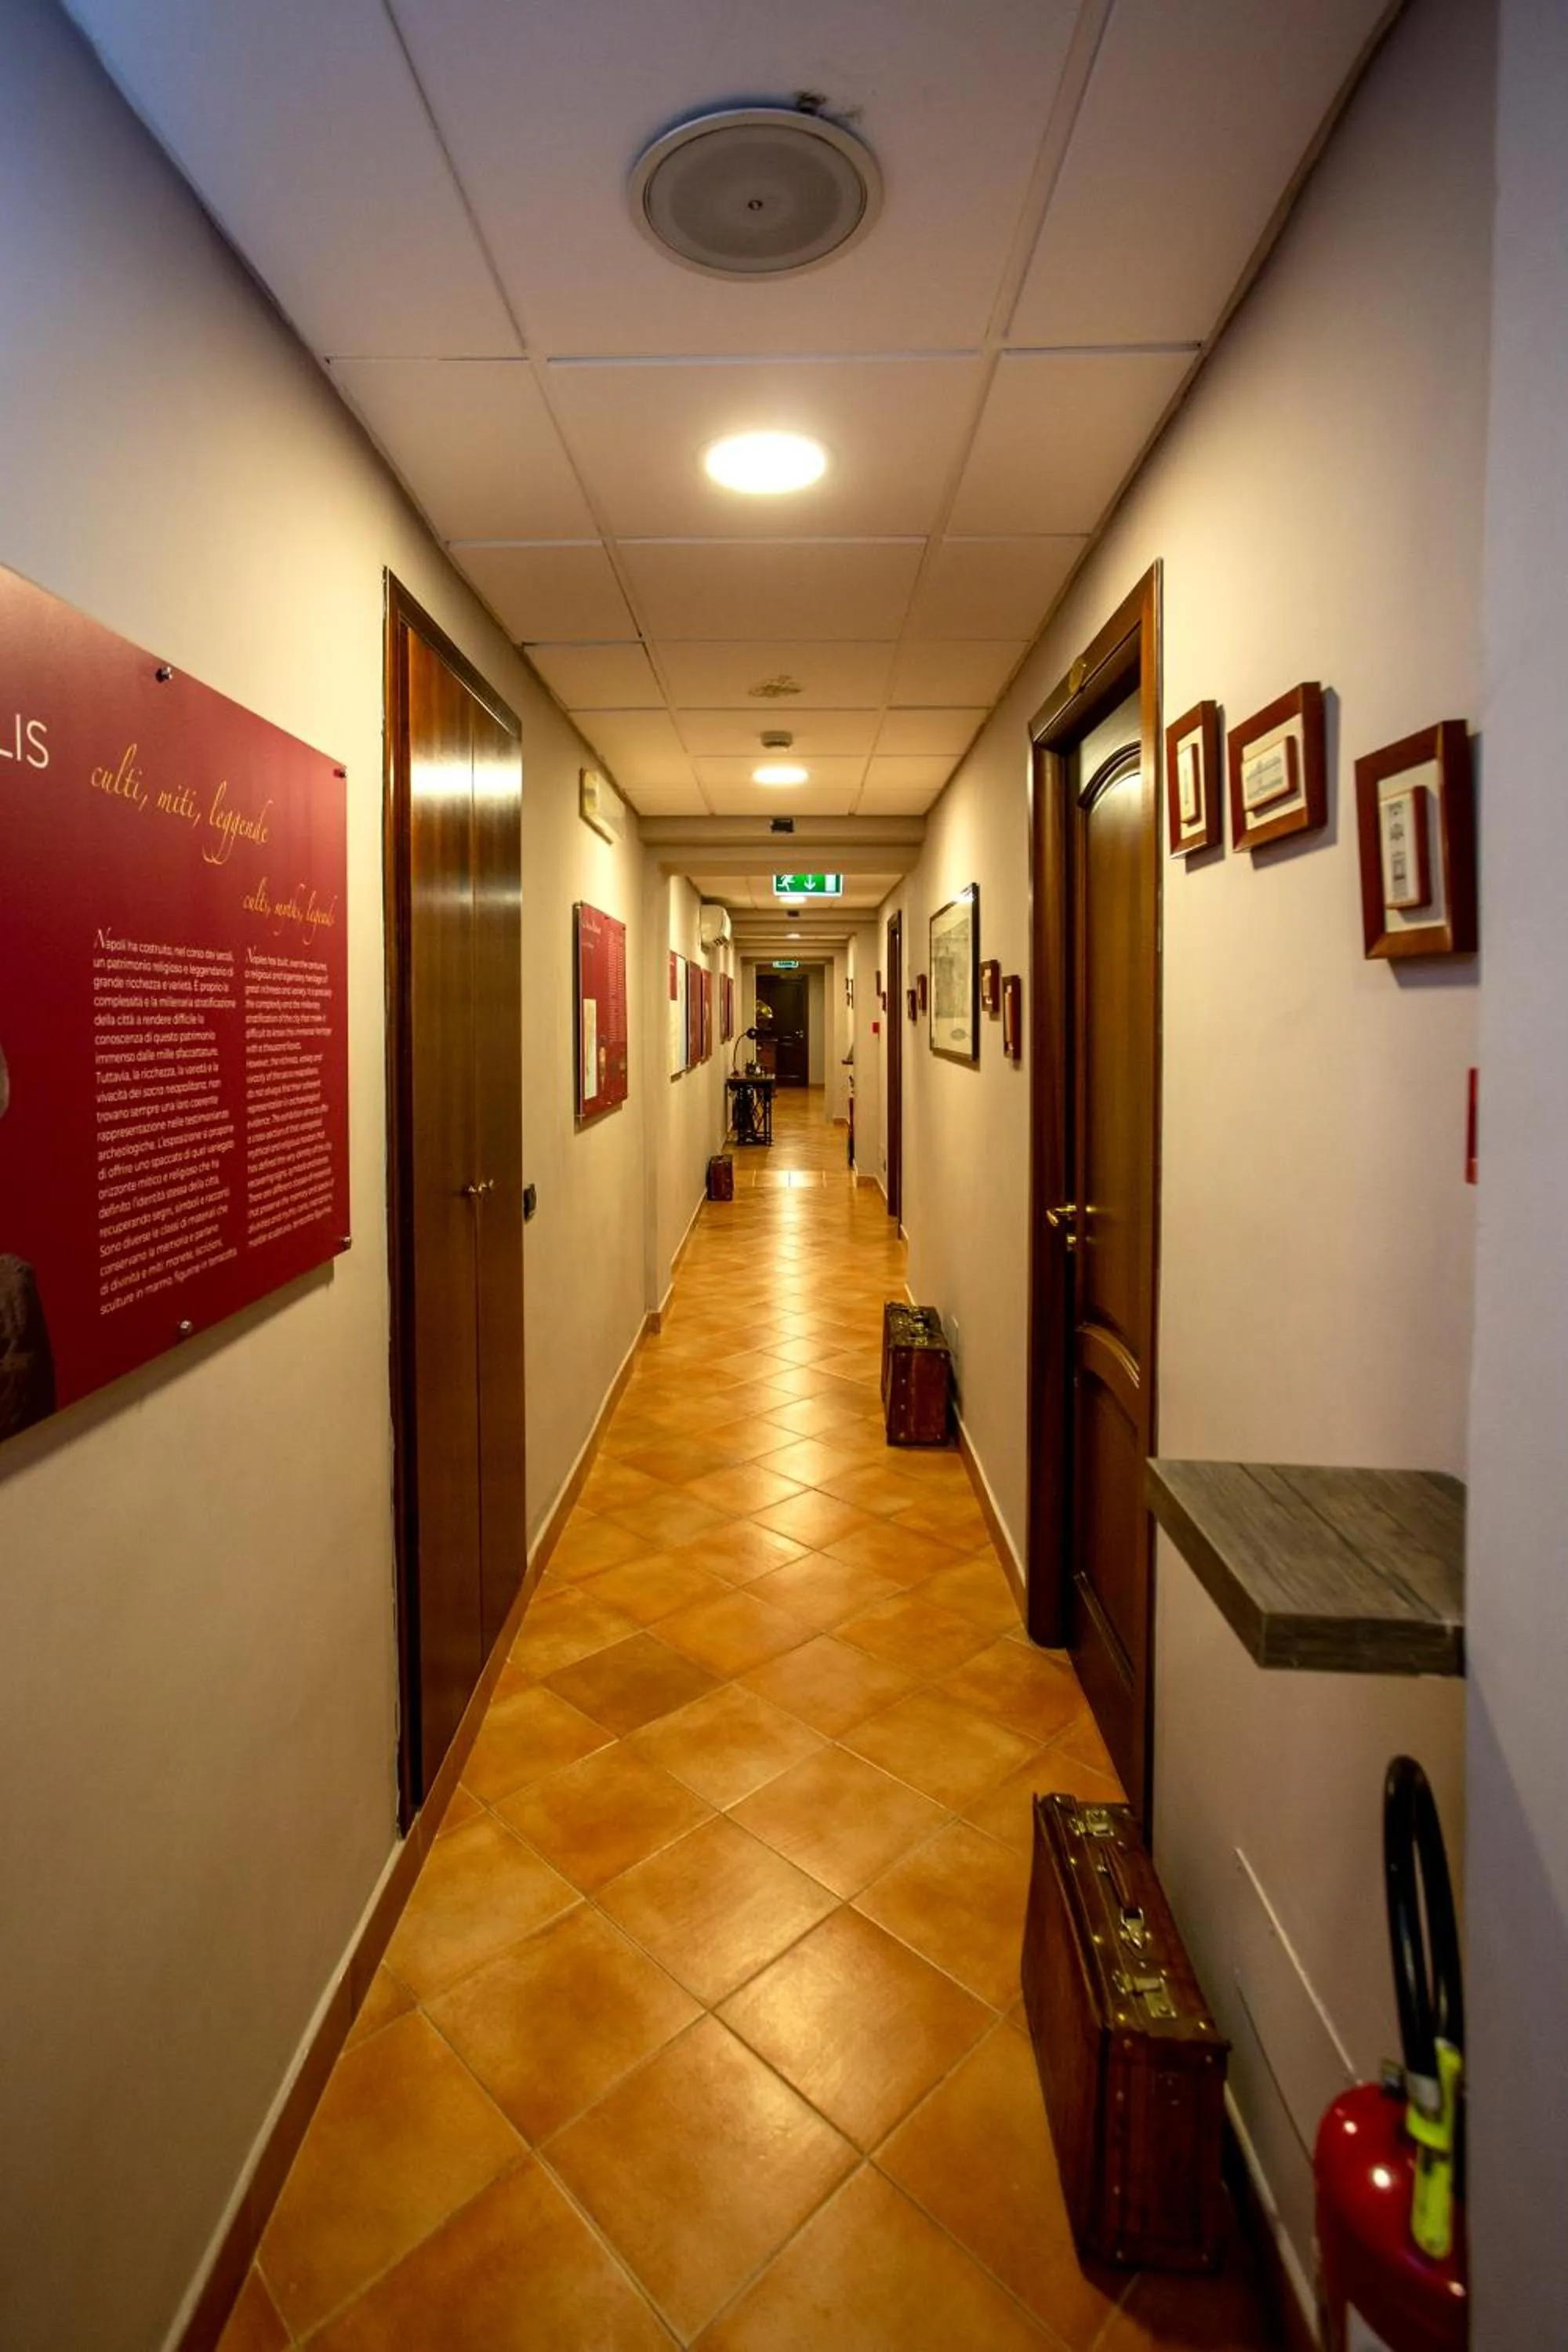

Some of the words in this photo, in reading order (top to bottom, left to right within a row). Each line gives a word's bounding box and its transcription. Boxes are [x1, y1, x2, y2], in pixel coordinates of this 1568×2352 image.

[91, 743, 148, 812] culti,
[157, 784, 201, 828] miti,
[202, 781, 274, 865] leggende
